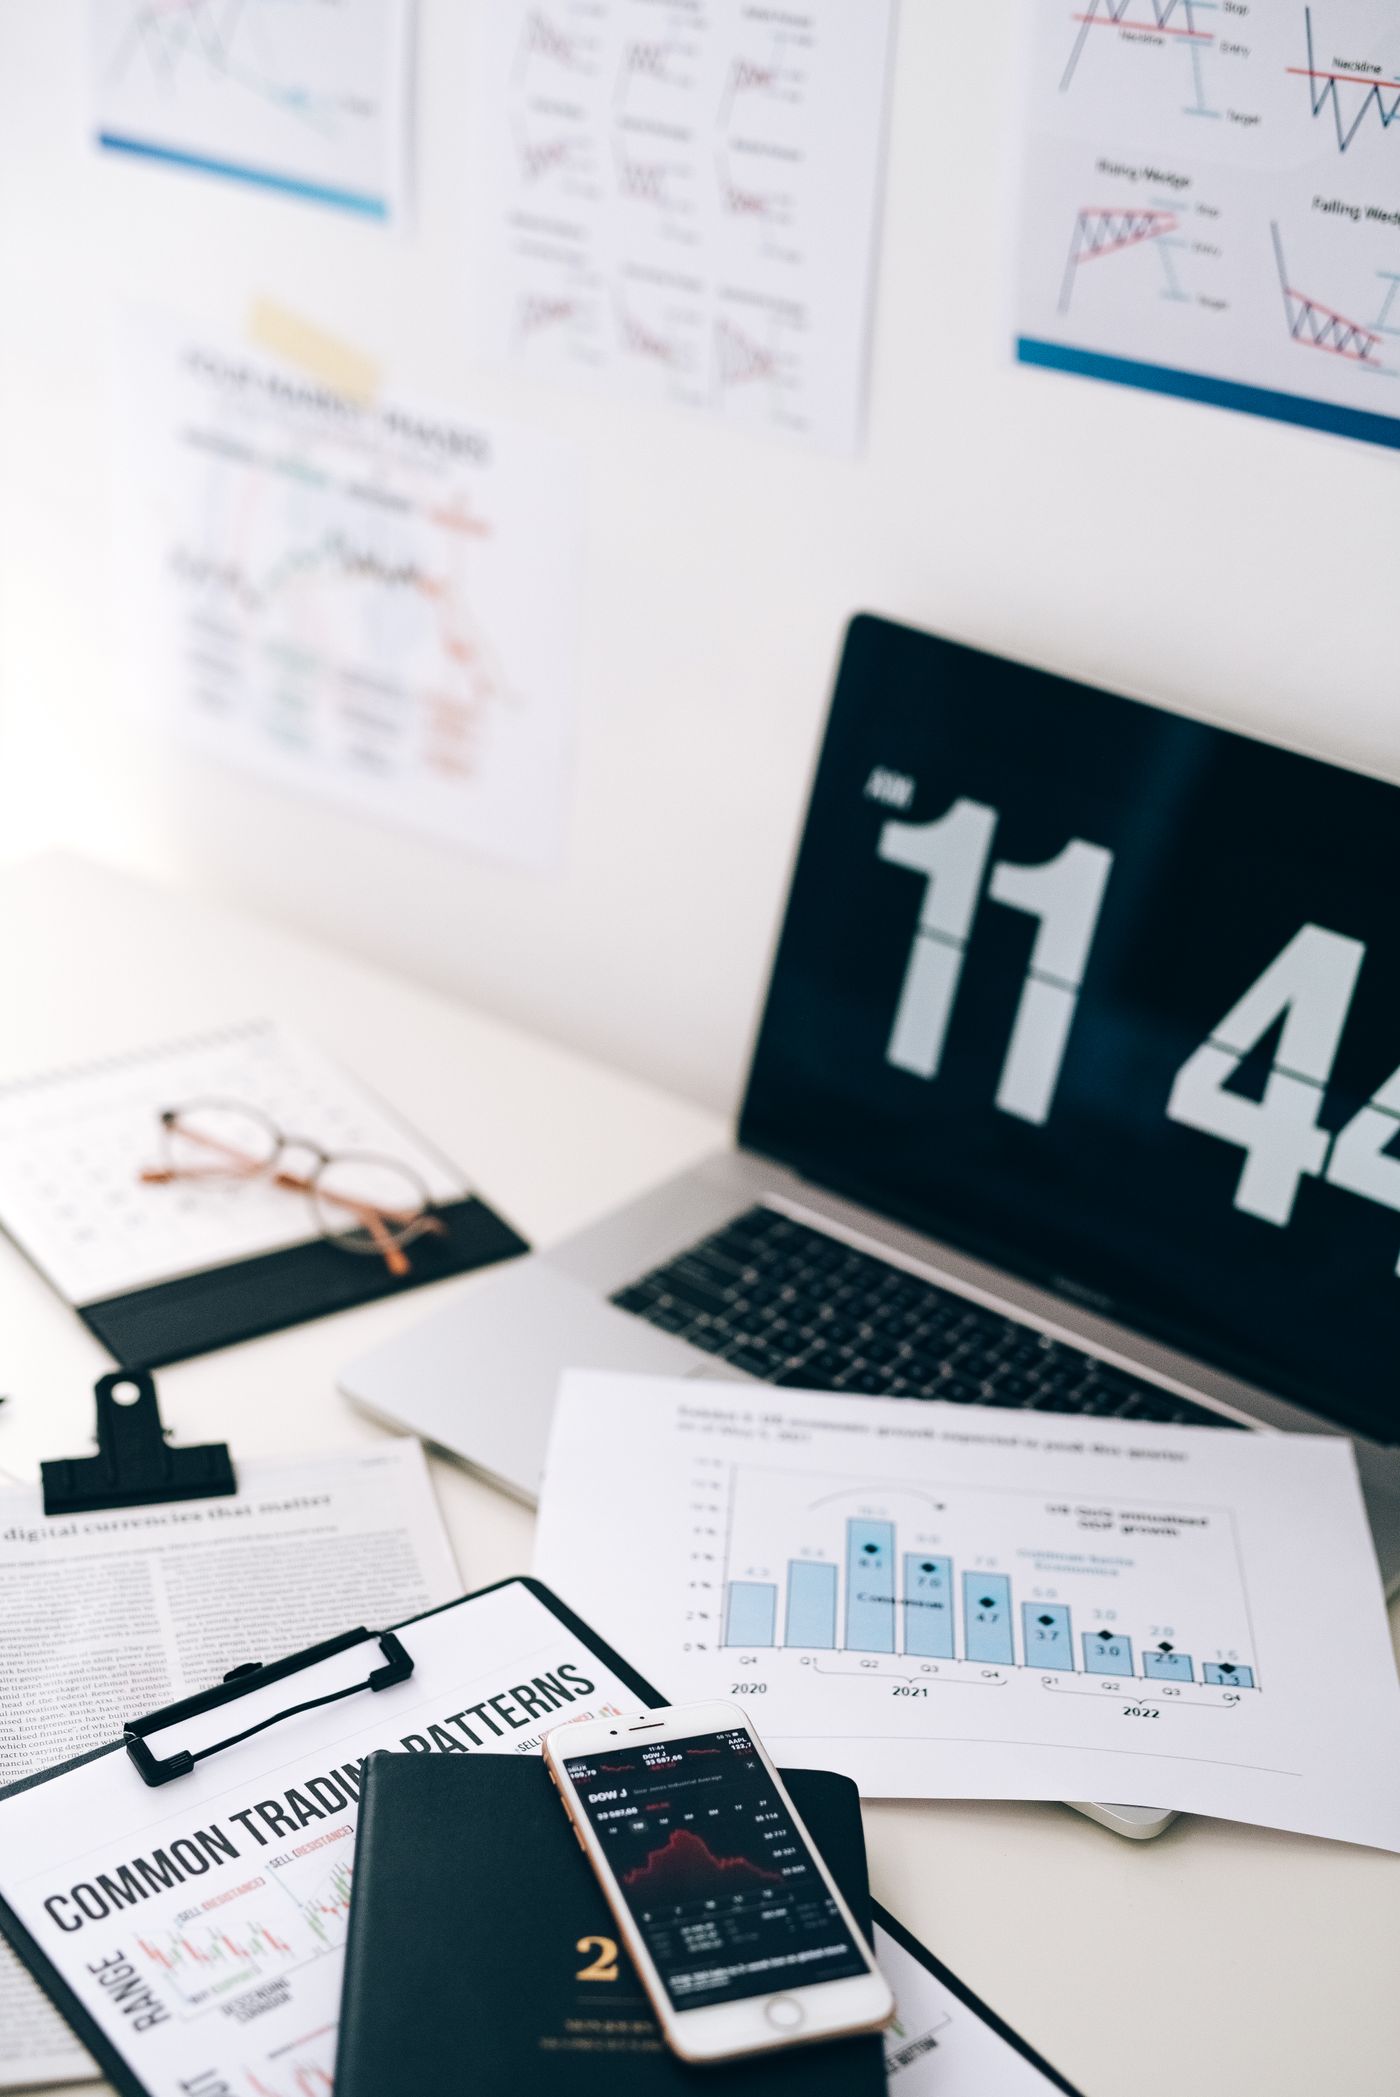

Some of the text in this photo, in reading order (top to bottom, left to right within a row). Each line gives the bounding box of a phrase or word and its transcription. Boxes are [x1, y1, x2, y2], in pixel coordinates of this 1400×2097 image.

[877, 797, 1114, 1127] 11
[4, 1494, 332, 1542] digital currencies that matter
[976, 1612, 999, 1623] 4.7
[1036, 1630, 1059, 1642] 3.7
[1095, 1645, 1120, 1657] 3.0
[11, 1682, 41, 1691] treated
[740, 1656, 1241, 1702] Q4 Q1 Q2 Q3 Q4 Q1 Q2 Q3 Q4
[40, 1686, 80, 1696] wreckage
[94, 1680, 129, 1688] Lehman
[56, 1693, 87, 1701] Federal
[130, 1682, 172, 1693] grumbled
[70, 1708, 96, 1716] Banks
[123, 1698, 175, 1710] modernised
[731, 1683, 1160, 1719] 2020 2021 2022
[10, 1705, 58, 1716] innovation
[19, 1719, 82, 1732] Entrepreneurs
[108, 1712, 129, 1720] built
[91, 1722, 118, 1730] which
[0, 1742, 26, 1750] which
[28, 1738, 67, 1748] contains
[104, 1728, 123, 1737] toke
[517, 1737, 541, 1752] SELL
[731, 1742, 751, 1750] 122,7
[30, 1746, 63, 1757] varying
[65, 1741, 98, 1751] degrees
[649, 1744, 665, 1752] 11:44
[643, 1752, 660, 1760] DOW
[43, 1664, 595, 1932] COMMON TRADIN PATTERNS
[588, 1788, 628, 1803] DOW J
[270, 1853, 294, 1868] SELL
[178, 1907, 203, 1922] SELL
[576, 1936, 619, 1982] 2
[87, 1951, 171, 2033] RANGE
